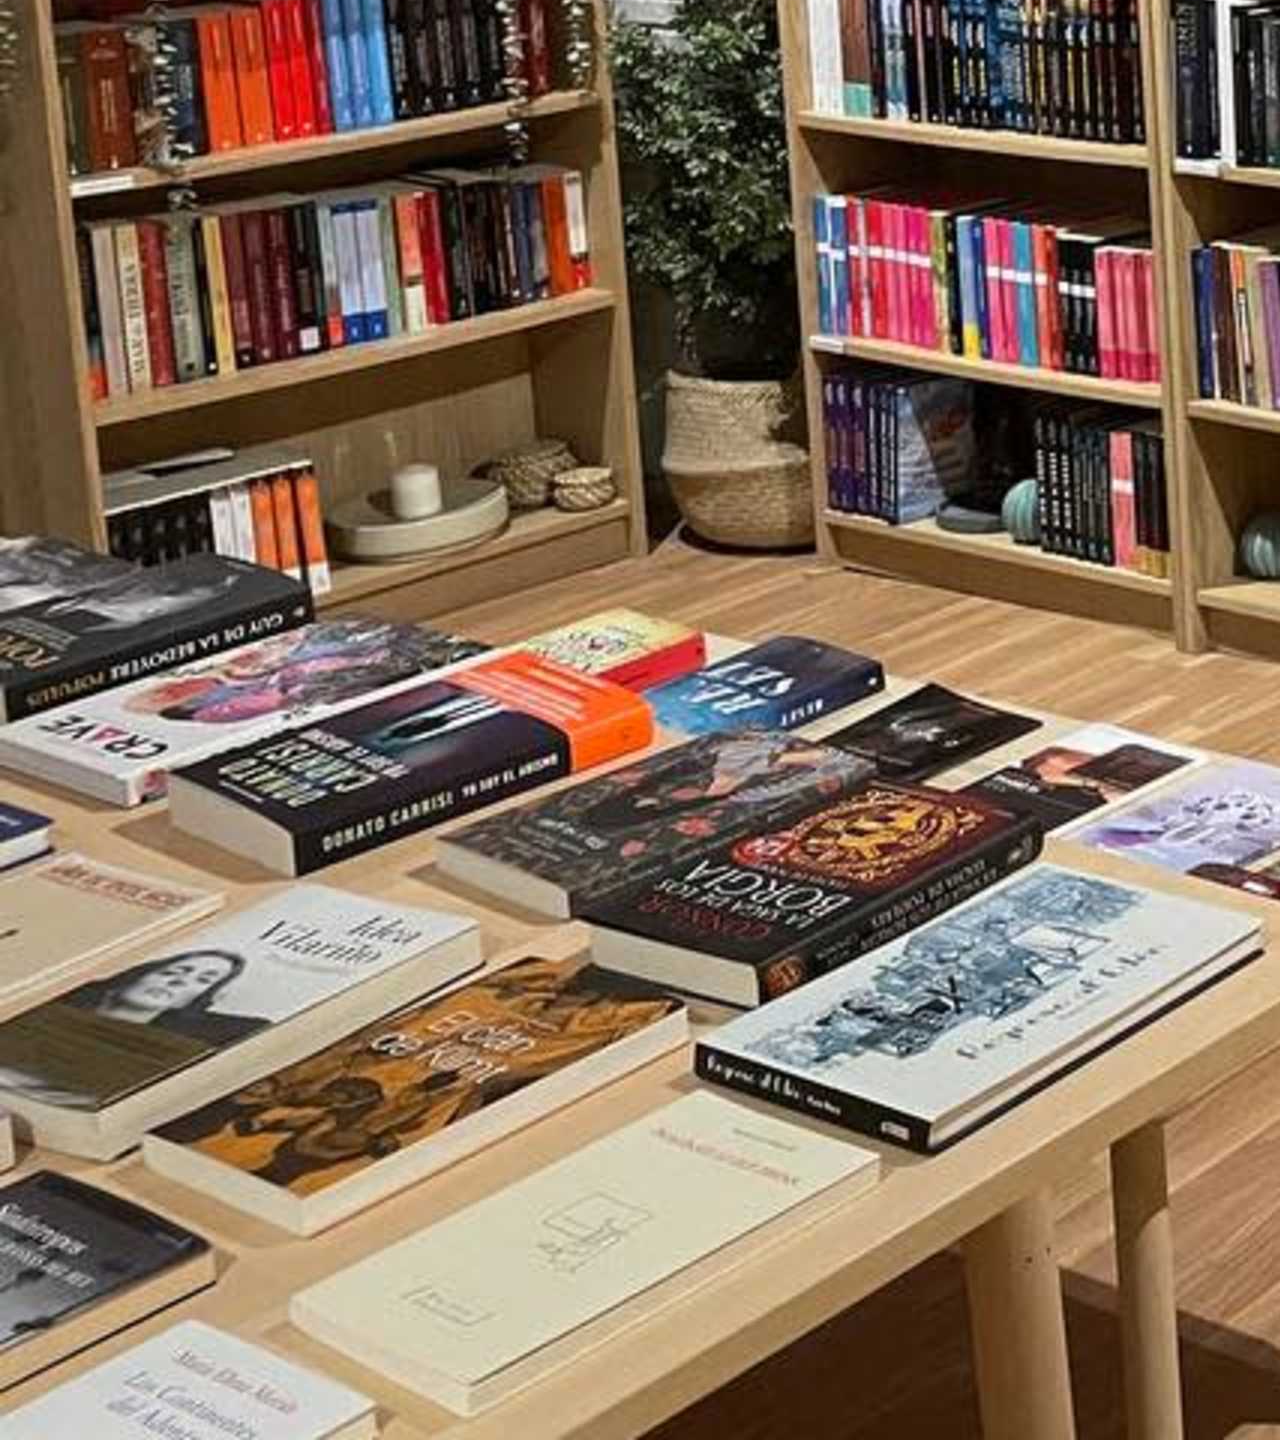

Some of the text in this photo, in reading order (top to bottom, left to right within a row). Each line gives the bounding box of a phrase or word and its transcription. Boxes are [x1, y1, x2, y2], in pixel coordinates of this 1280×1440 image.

[248, 611, 285, 633] GUY
[38, 714, 168, 761] CRAVE
[322, 792, 455, 853] DONATO CARRISI
[654, 878, 693, 899] LOS
[679, 859, 852, 919] BORGIA
[698, 890, 730, 909] DE
[347, 914, 422, 946] Idea
